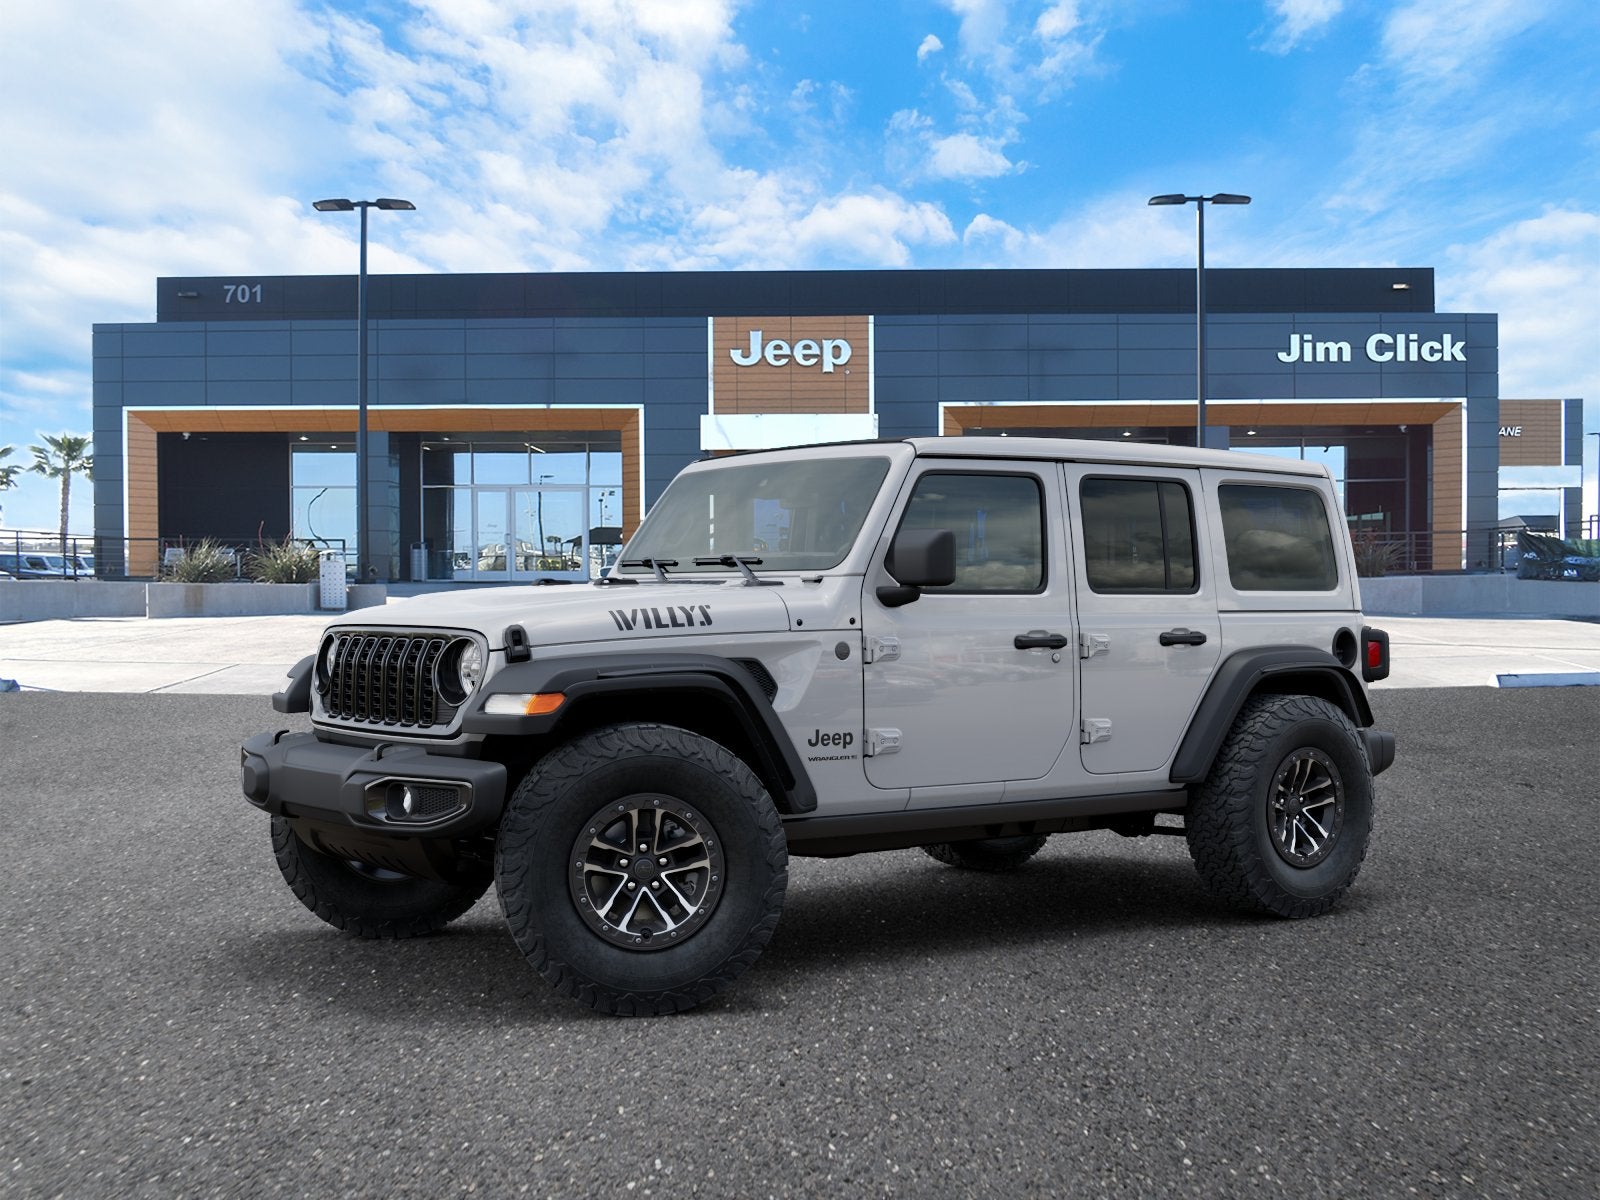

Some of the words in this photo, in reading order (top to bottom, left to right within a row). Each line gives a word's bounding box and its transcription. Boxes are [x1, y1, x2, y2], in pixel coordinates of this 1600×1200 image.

[223, 284, 262, 303] 701
[729, 330, 852, 374] Jeep
[1277, 333, 1352, 363] Jim
[1366, 333, 1467, 362] Click
[607, 604, 713, 632] WILLYS
[807, 729, 854, 749] Jeep
